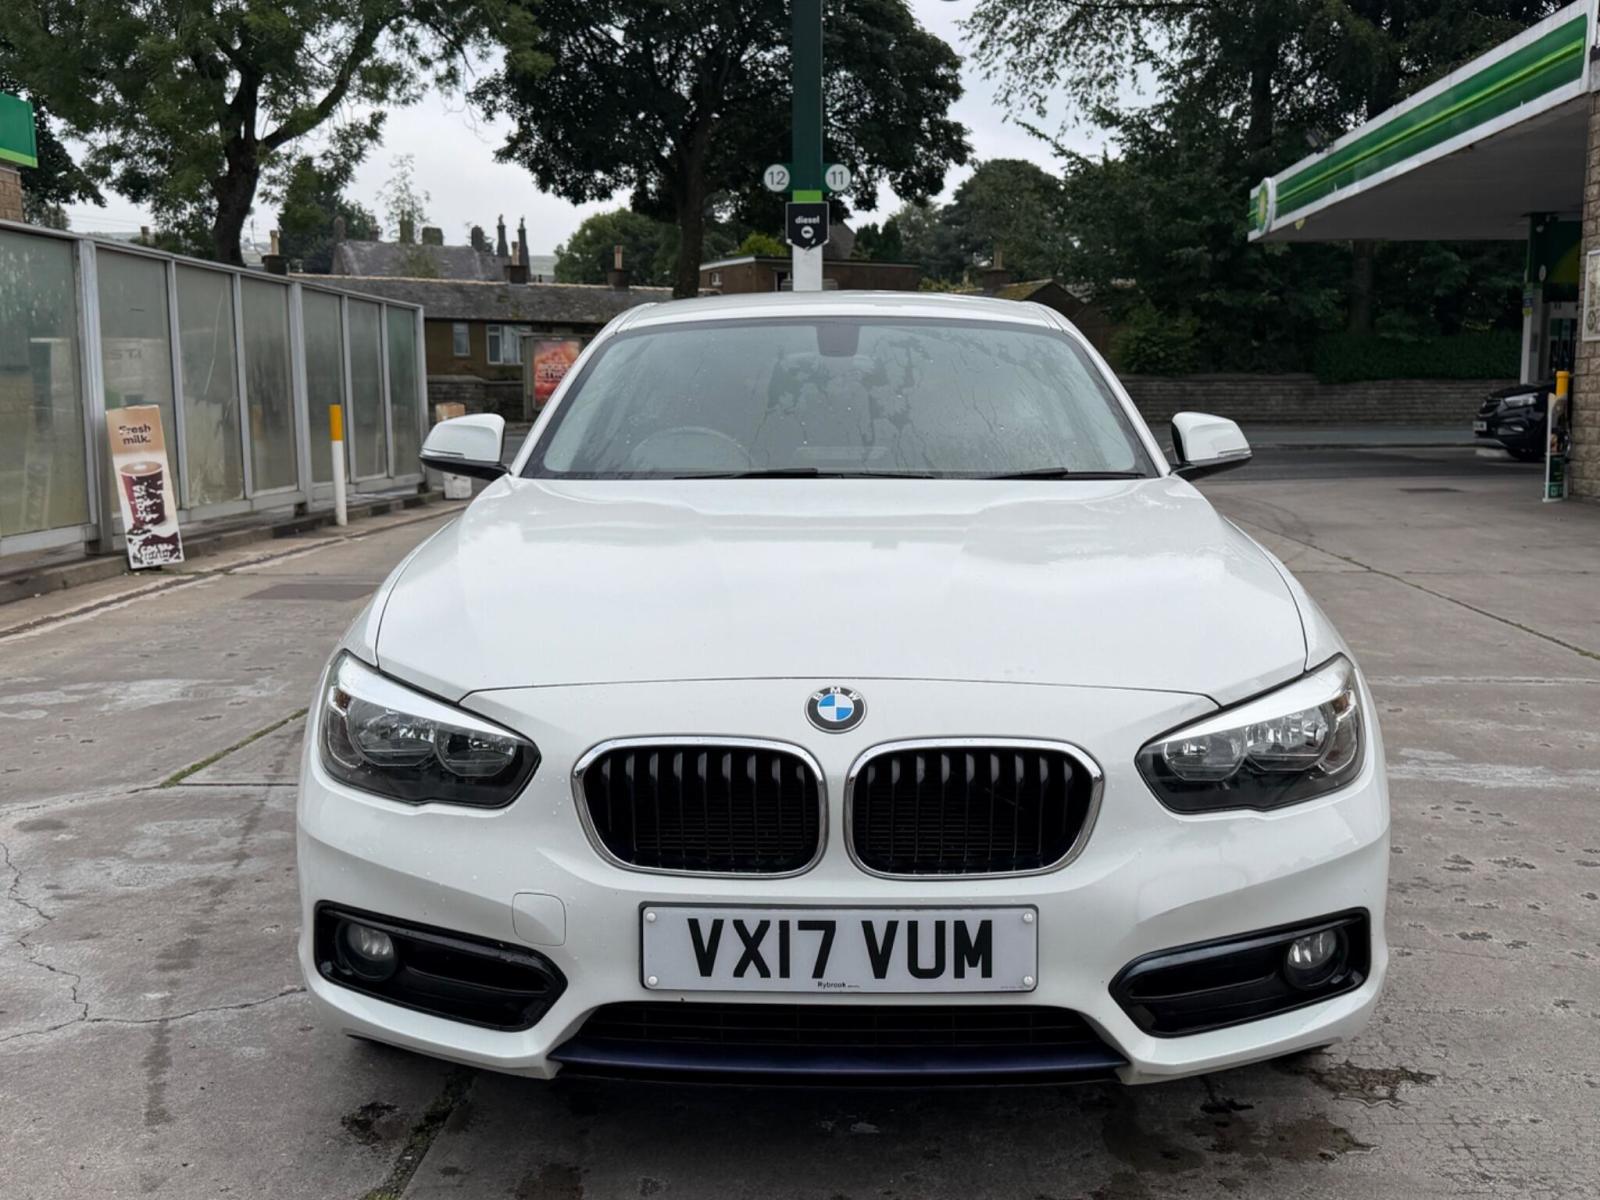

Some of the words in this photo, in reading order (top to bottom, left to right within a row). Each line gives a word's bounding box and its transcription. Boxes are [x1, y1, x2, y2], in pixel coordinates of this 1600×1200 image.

[769, 171, 786, 186] 12
[830, 171, 844, 185] 11
[795, 215, 820, 224] diesel
[687, 918, 837, 979] VX17
[861, 920, 993, 979] VUM
[817, 981, 846, 989] Rybrook
